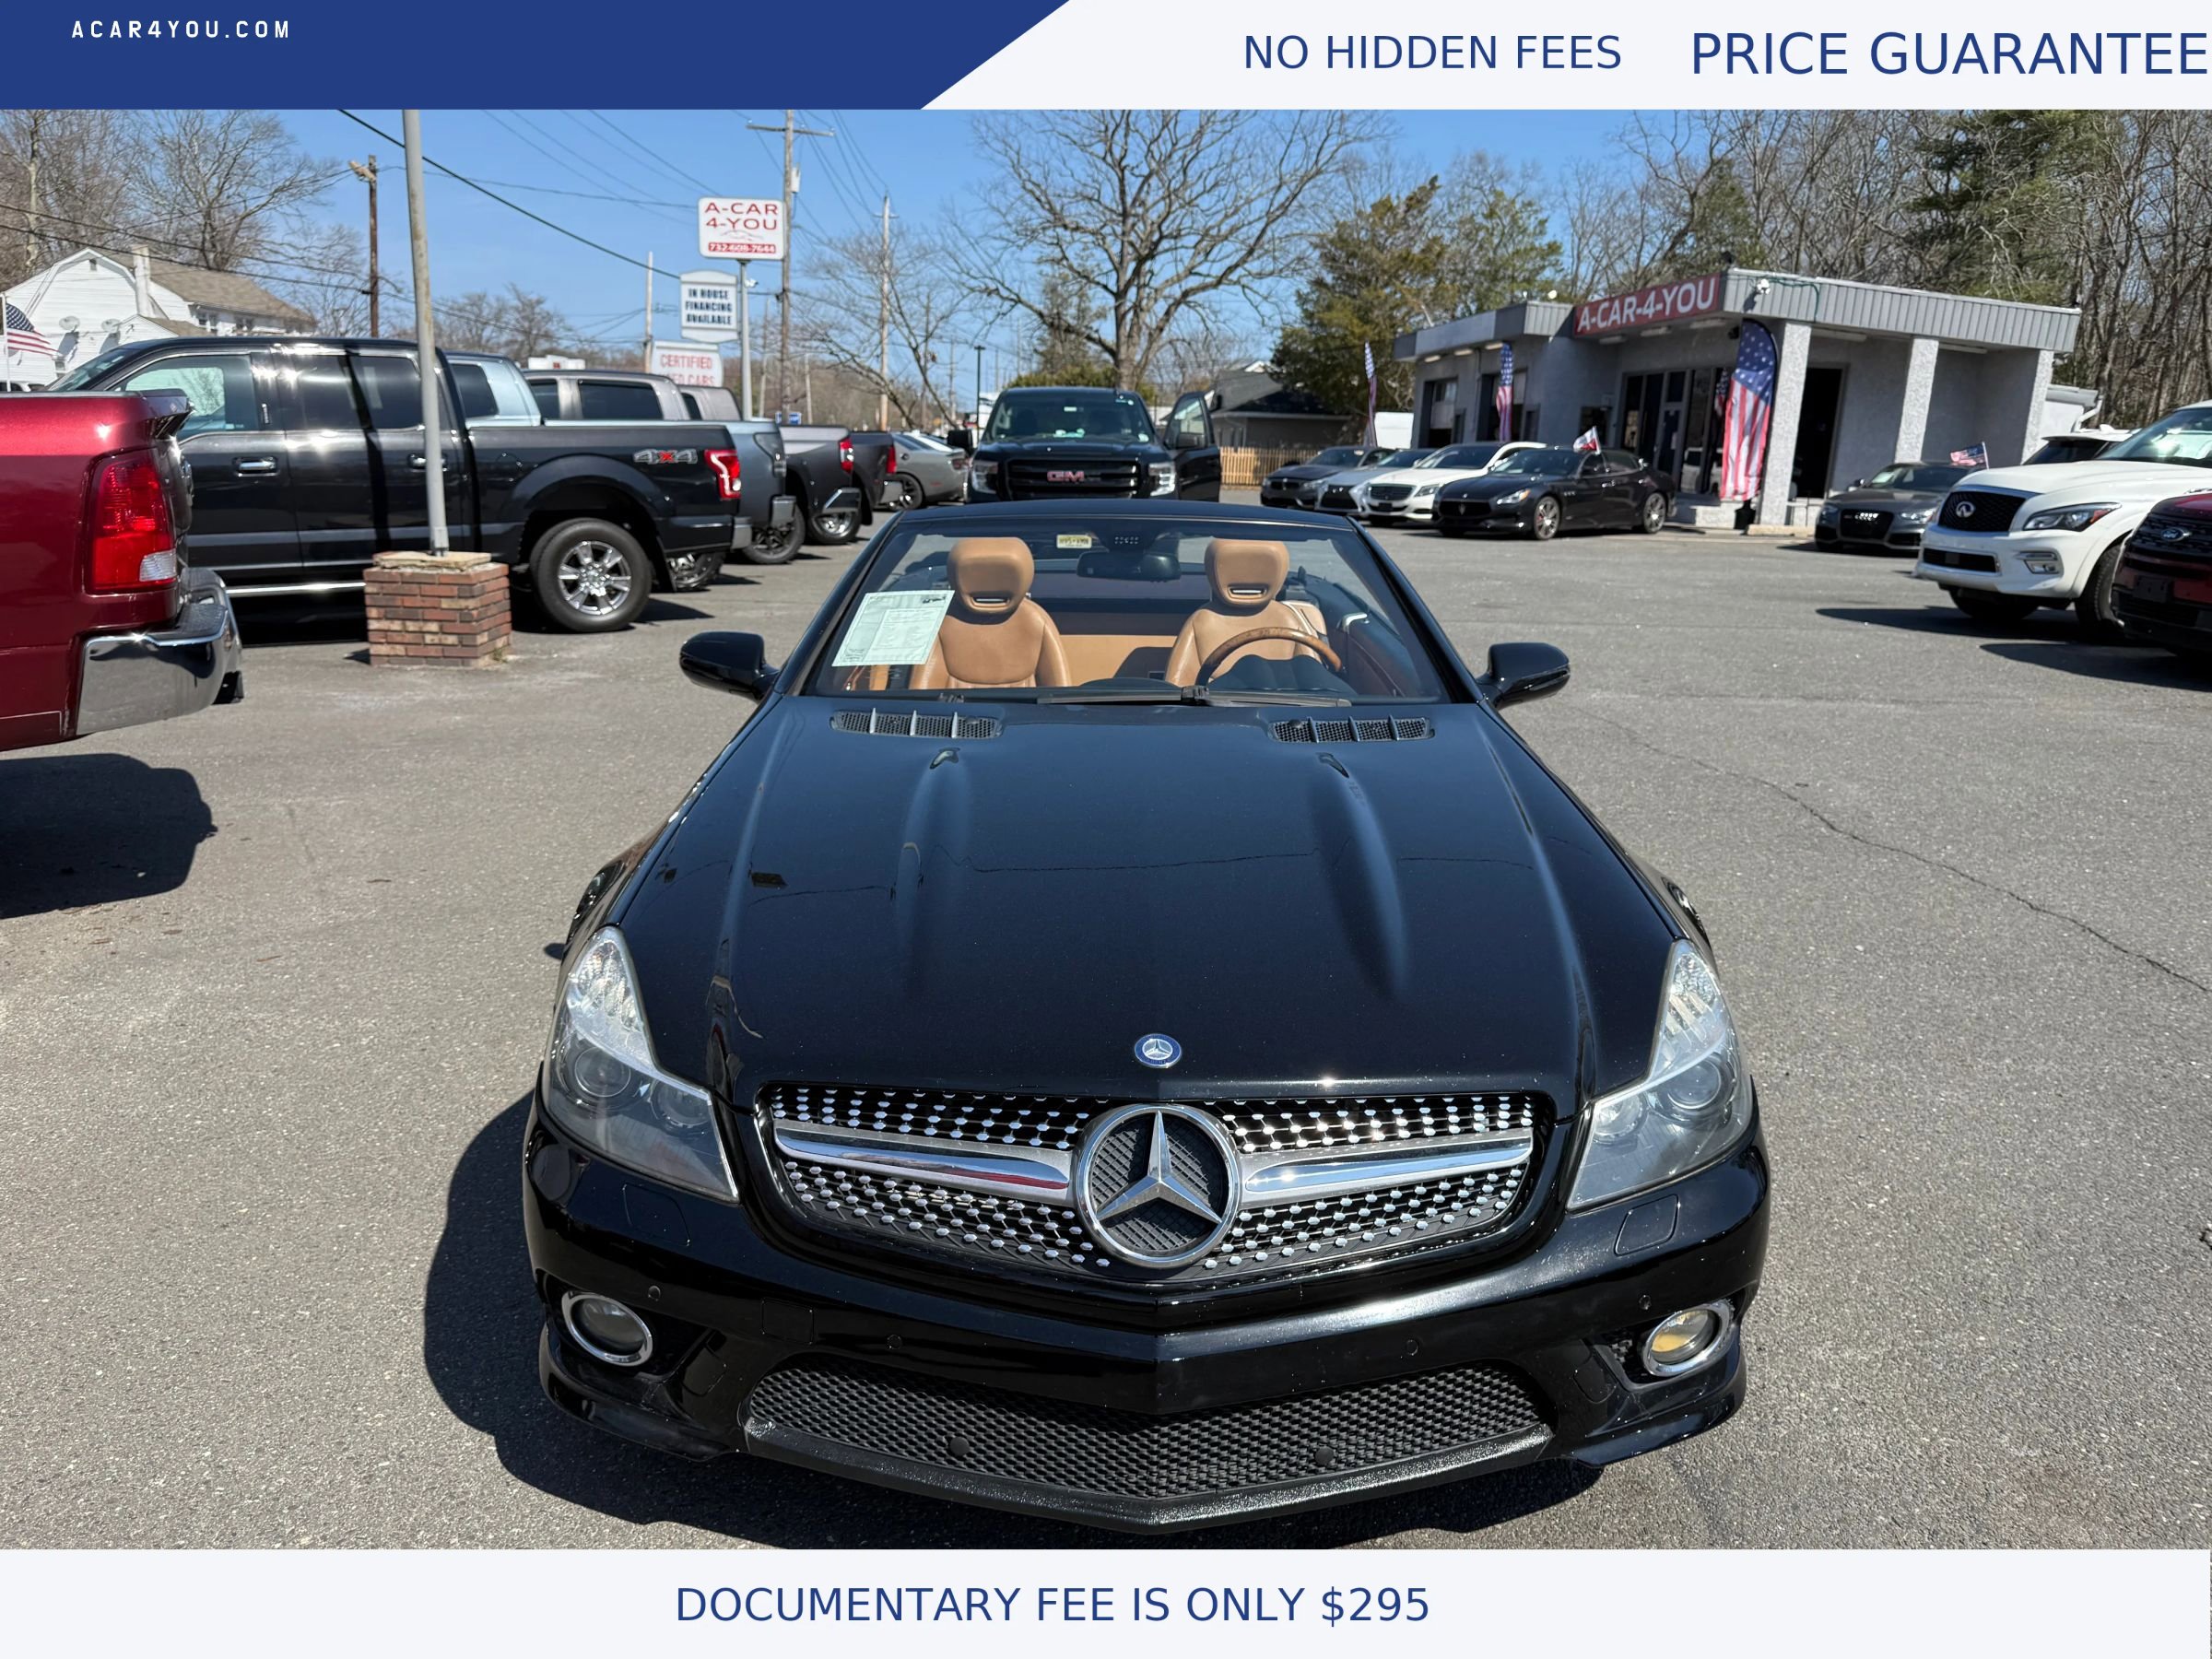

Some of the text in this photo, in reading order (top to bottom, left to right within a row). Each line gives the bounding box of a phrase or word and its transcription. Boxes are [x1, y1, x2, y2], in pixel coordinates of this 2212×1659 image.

[704, 202, 778, 216] A-CAR
[705, 217, 777, 230] 4-YOU
[688, 288, 729, 300] IN HOUSE
[685, 300, 733, 312] FINANCING
[1577, 278, 1715, 333] A-CAR-4-YOU
[687, 313, 732, 325] AVAILABLE
[661, 355, 712, 369] CERTIFIED
